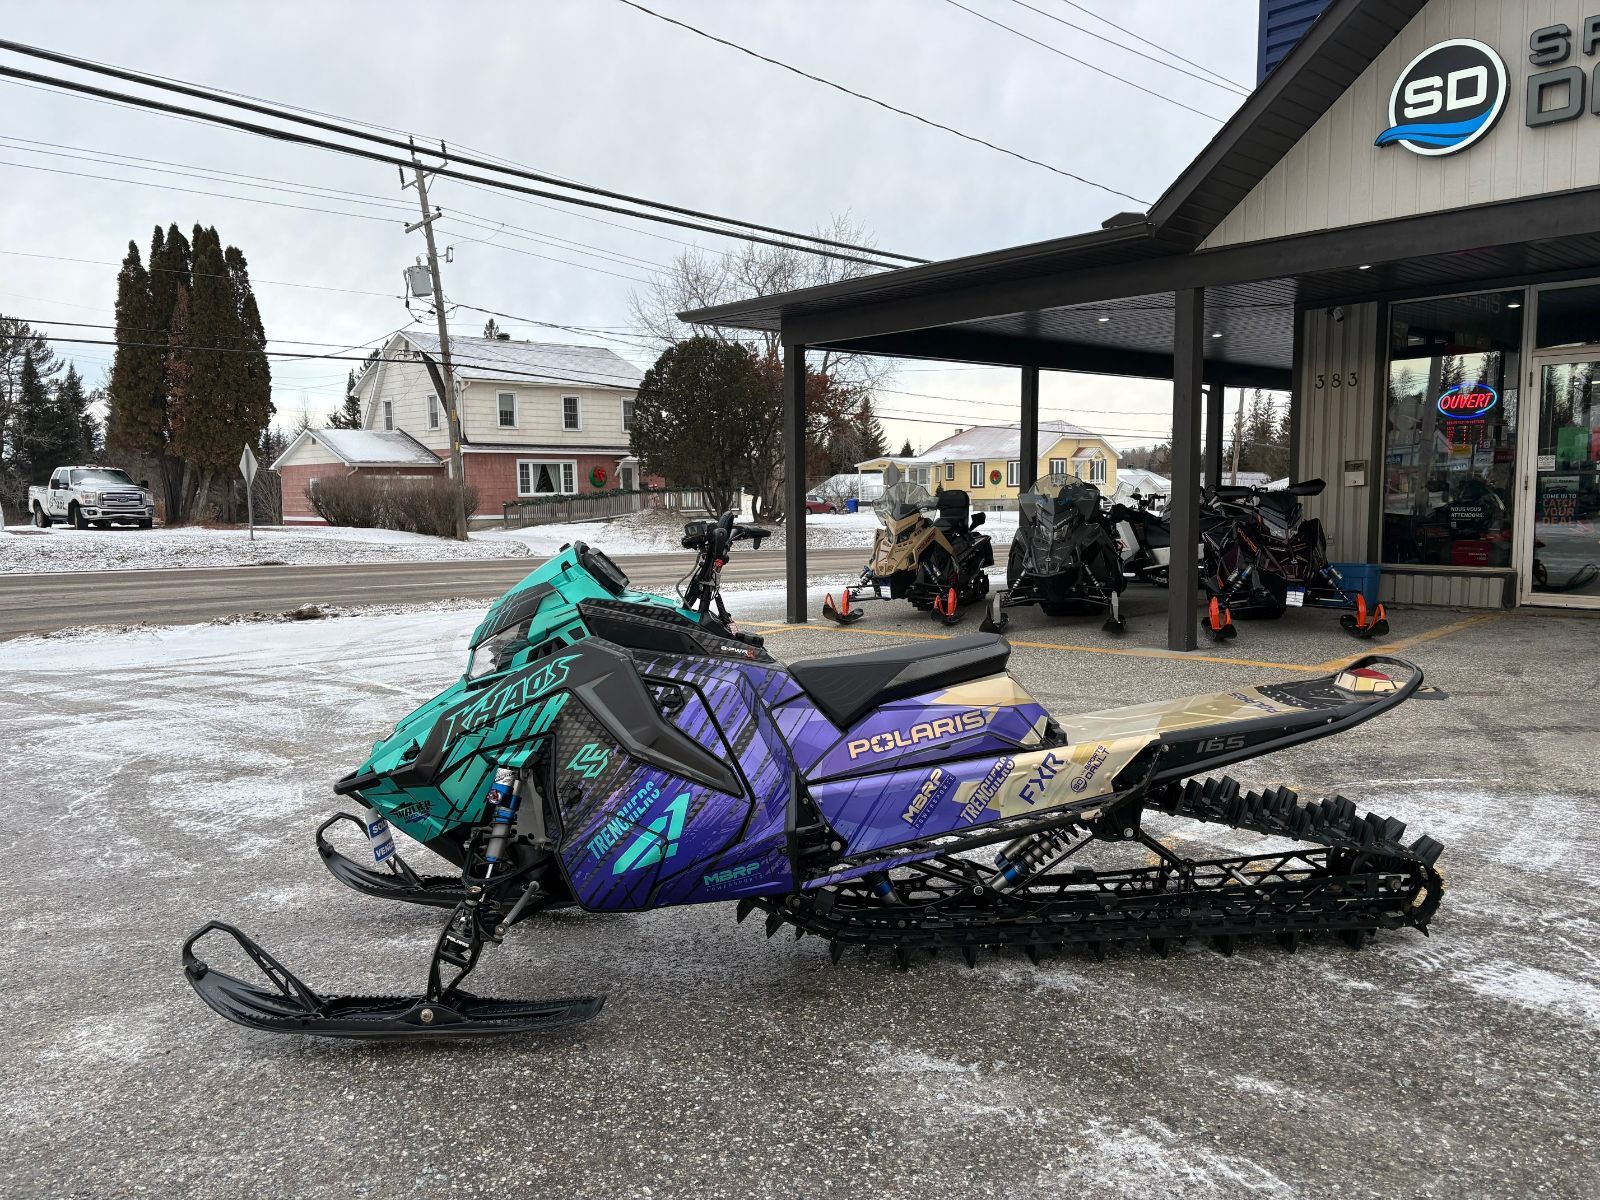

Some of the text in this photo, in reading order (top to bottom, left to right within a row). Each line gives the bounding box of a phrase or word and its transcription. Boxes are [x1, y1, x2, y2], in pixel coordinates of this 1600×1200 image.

[1404, 65, 1488, 119] SD
[1526, 62, 1600, 128] D
[1315, 372, 1358, 389] 383
[1441, 392, 1493, 410] OUVERT
[1542, 499, 1577, 508] CATCH
[1543, 507, 1576, 517] YOUR
[442, 653, 583, 752] KHAOS
[848, 709, 987, 761] POLARIS
[1196, 735, 1246, 753] 165
[1084, 744, 1104, 770] SPORTS
[1085, 747, 1110, 780] DAULT
[960, 756, 1015, 824] TRENCHERS
[1019, 752, 1065, 806] FXR
[1073, 779, 1084, 791] SD
[901, 767, 943, 825] MBRP
[587, 781, 661, 860] TRENCHERS
[703, 862, 760, 885] MBRP
